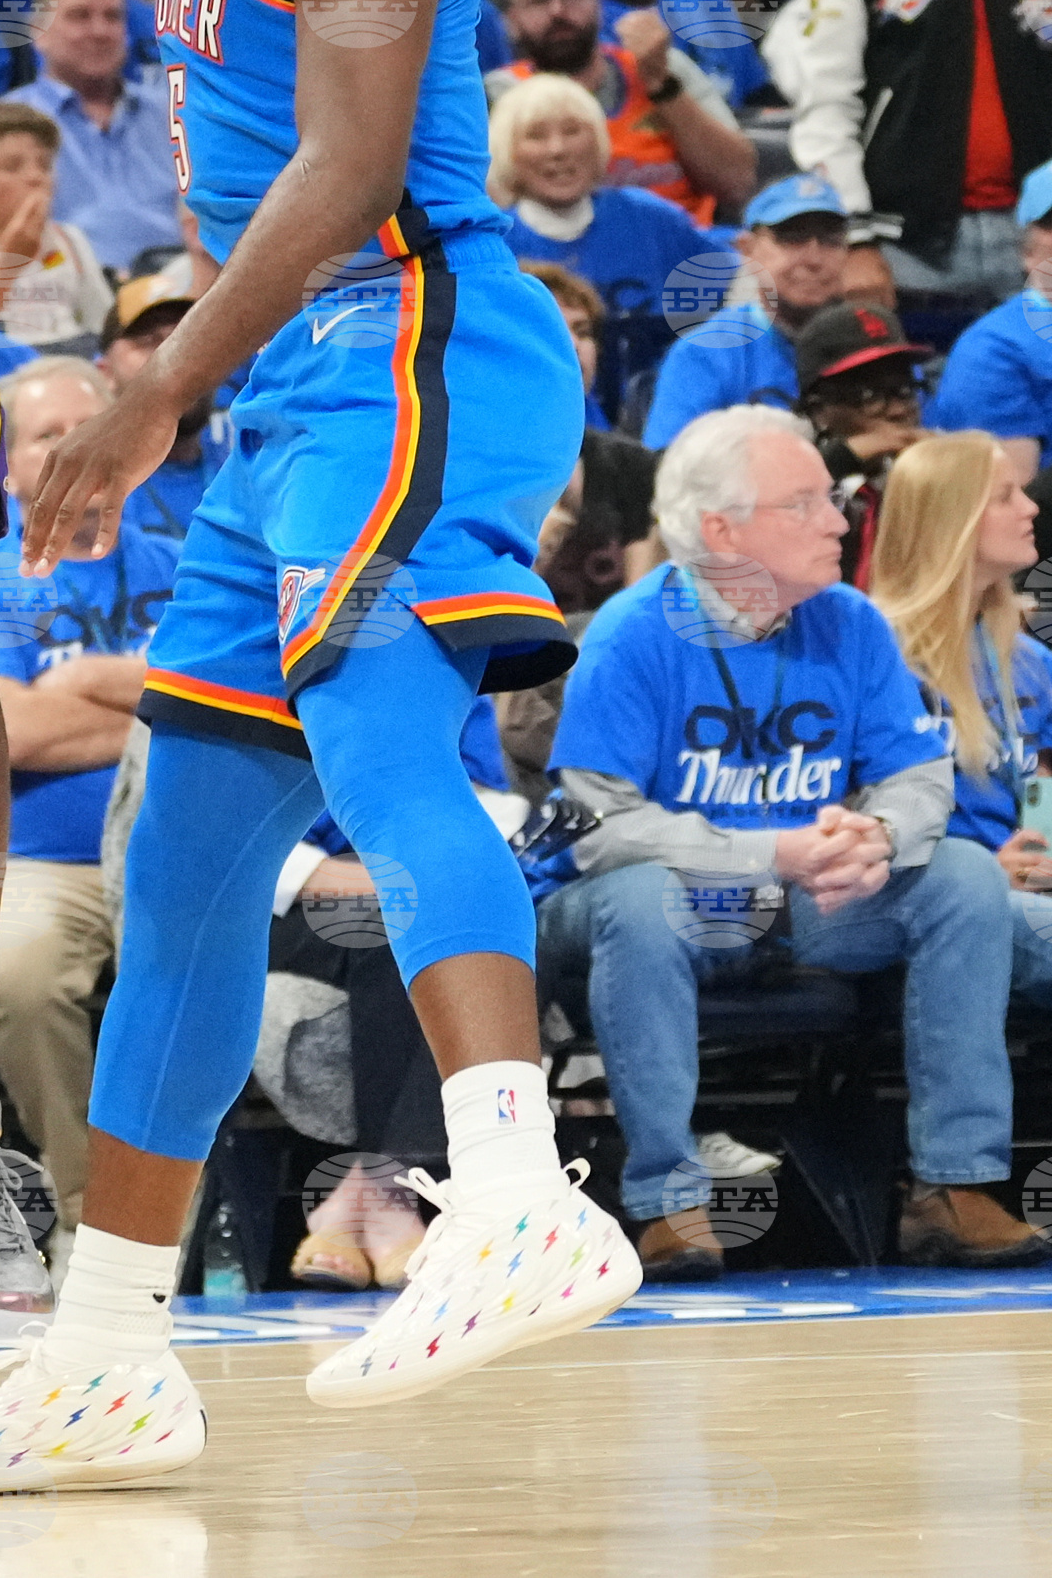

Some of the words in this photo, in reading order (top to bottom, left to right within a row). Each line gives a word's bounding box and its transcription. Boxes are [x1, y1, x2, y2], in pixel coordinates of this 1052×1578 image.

[167, 63, 192, 195] 5
[684, 700, 838, 759] OKC
[676, 743, 843, 805] Thunder
